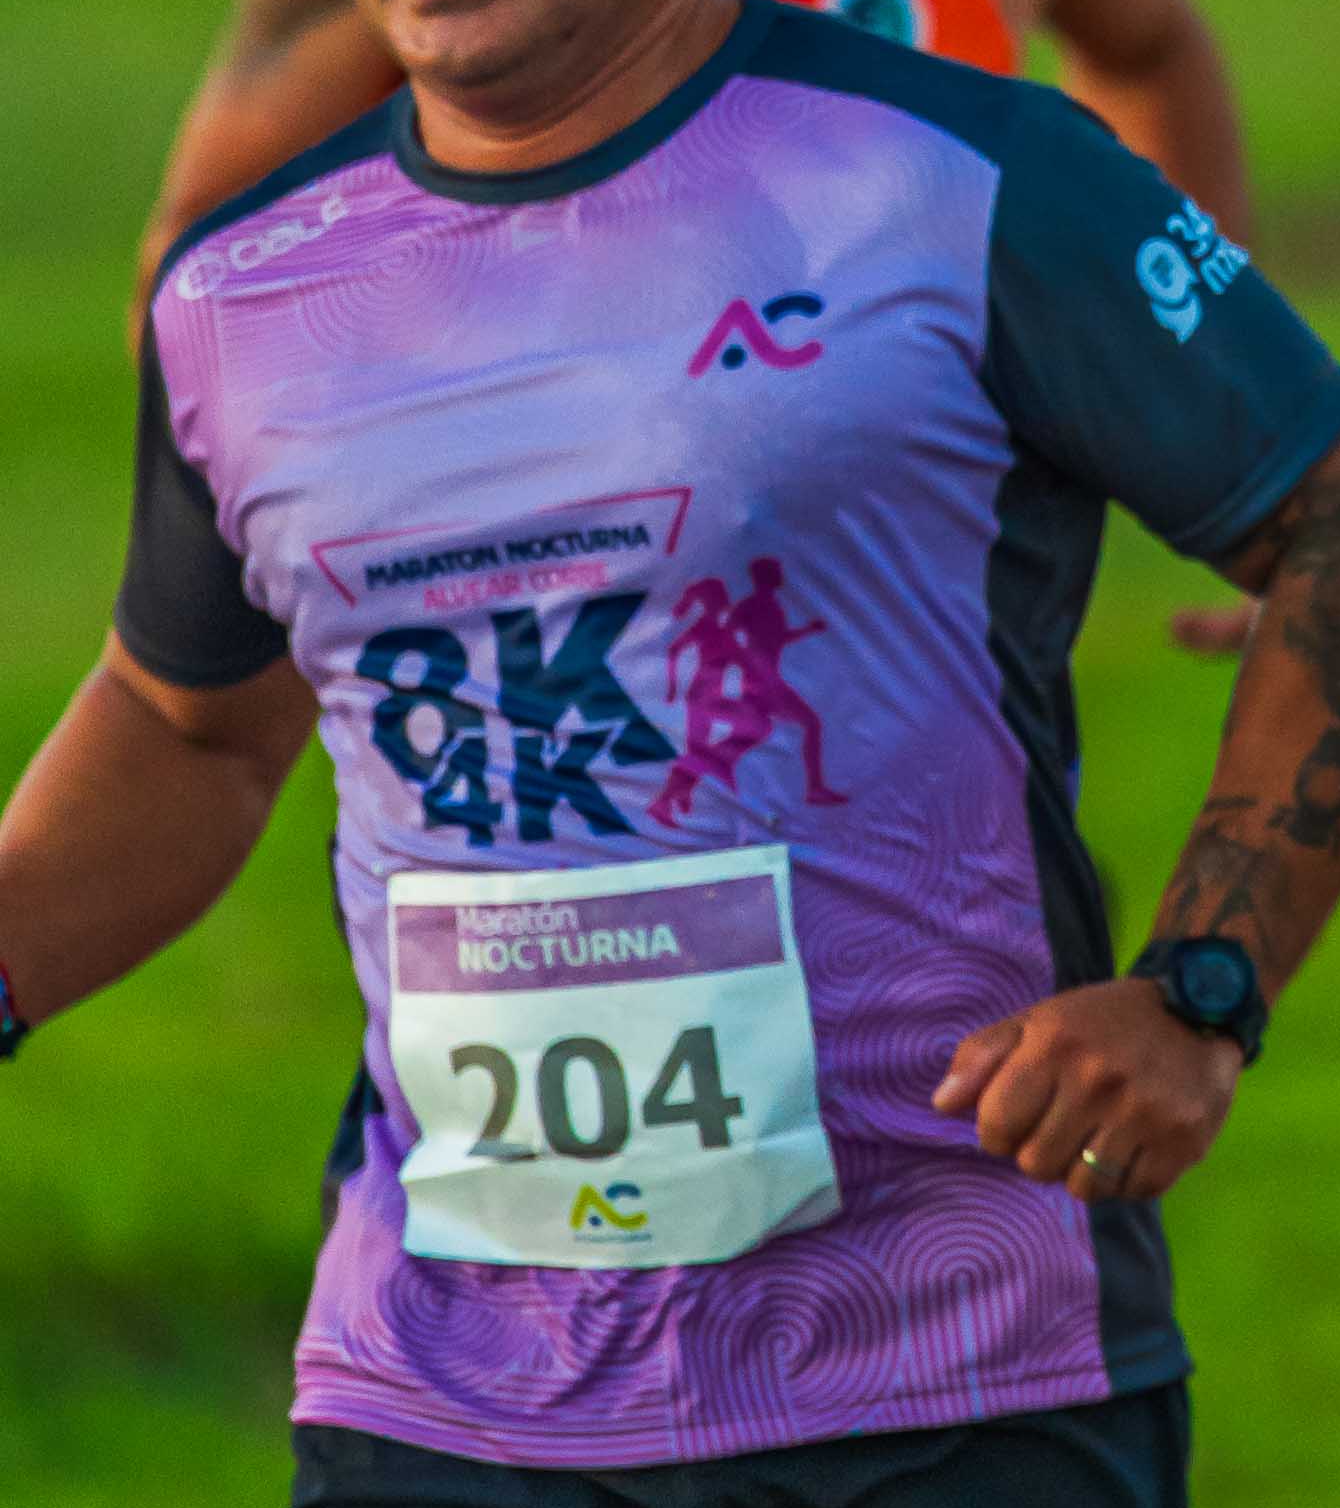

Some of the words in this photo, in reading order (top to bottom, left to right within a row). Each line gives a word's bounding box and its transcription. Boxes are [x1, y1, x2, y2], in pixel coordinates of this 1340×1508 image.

[356, 590, 679, 785] 8K
[424, 735, 637, 848] 4K
[455, 897, 580, 935] Maratón
[458, 923, 681, 975] NOCTURNA
[450, 1025, 744, 1164] 204
